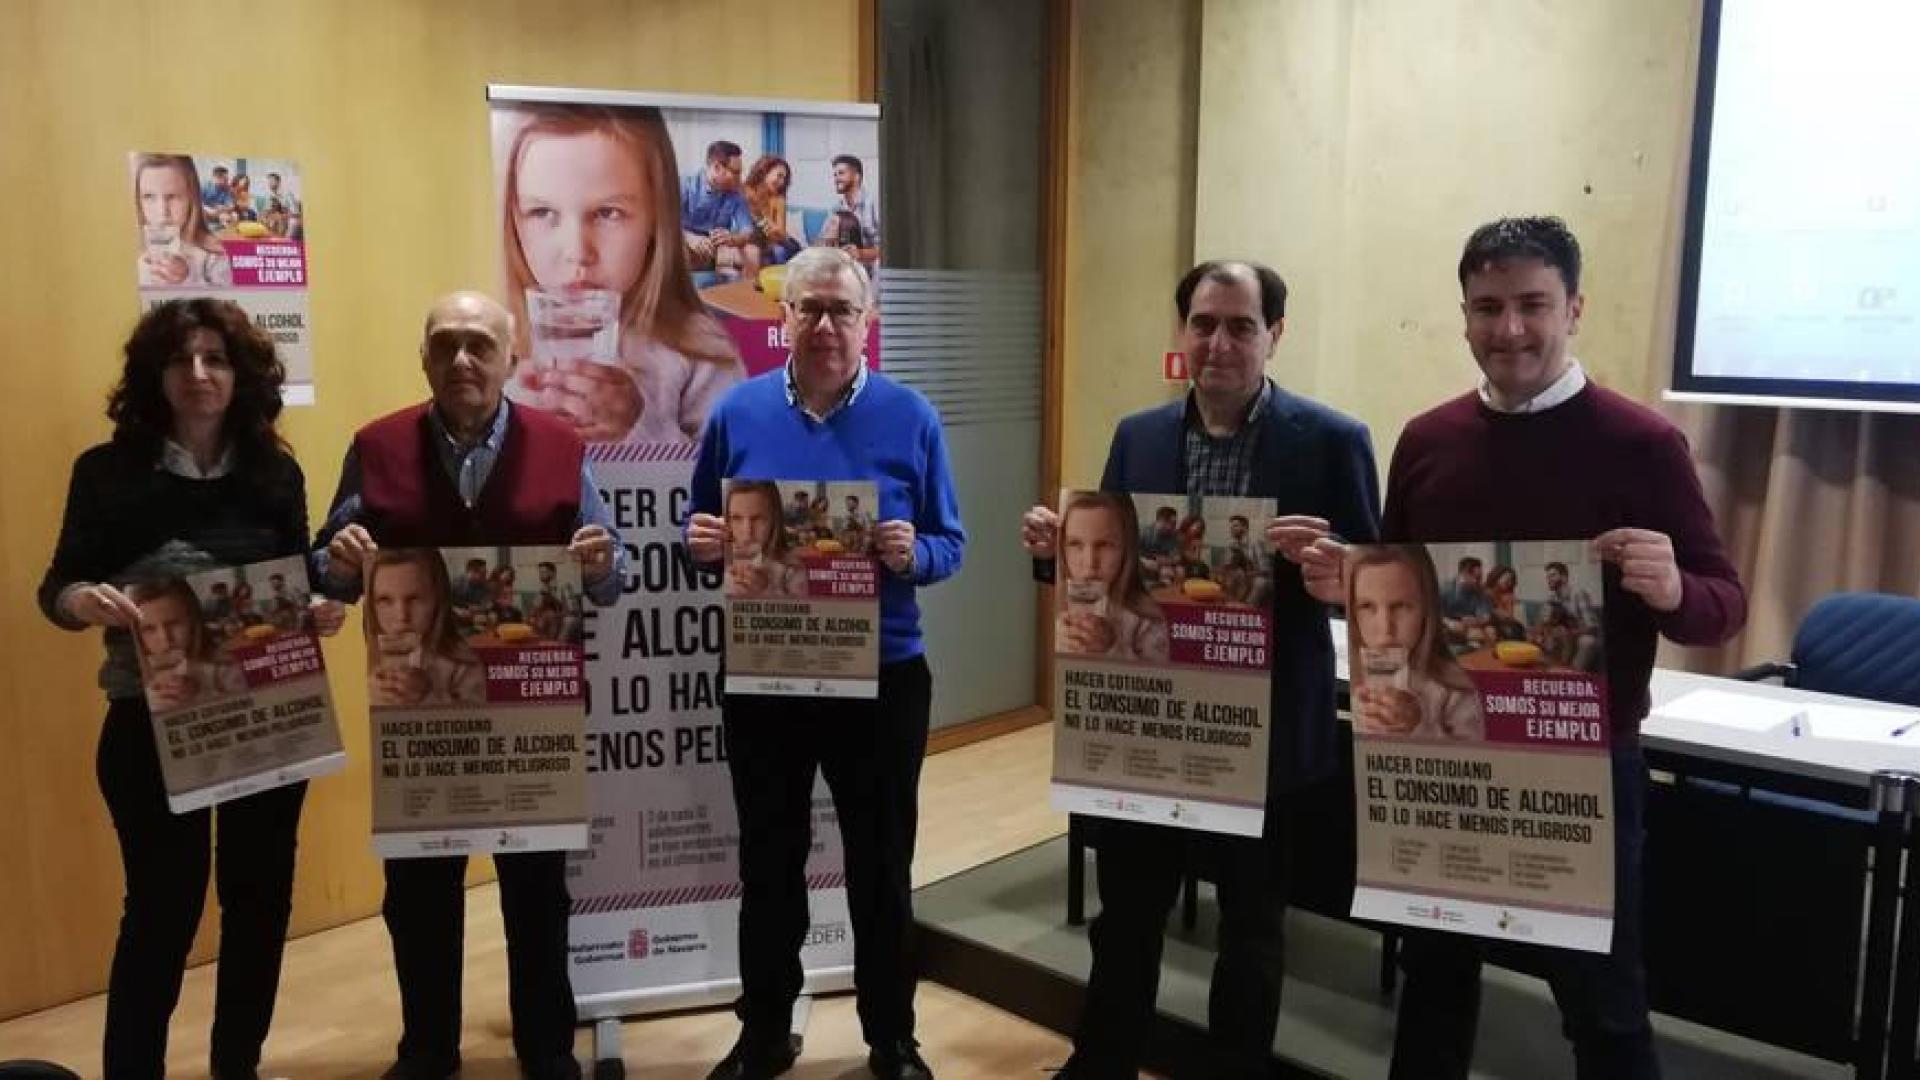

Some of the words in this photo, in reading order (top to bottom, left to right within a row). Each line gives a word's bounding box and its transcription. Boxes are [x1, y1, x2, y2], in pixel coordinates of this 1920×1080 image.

[622, 605, 724, 658] ALCO
[825, 618, 875, 632] ALCOHOL
[1173, 624, 1214, 640] SOMOS
[1231, 630, 1265, 646] MEJOR
[1204, 645, 1265, 664] EJEMPLO
[521, 681, 579, 697] EJEMPLO
[1065, 670, 1104, 688] HACER
[1108, 674, 1172, 694] COTIDIANO
[1523, 679, 1598, 697] RECUERDA:
[612, 676, 649, 715] LO
[1486, 695, 1535, 714] SOMOS
[1539, 700, 1555, 716] SU
[1559, 700, 1599, 717] MEJOR
[1065, 690, 1081, 709] EL
[1089, 691, 1159, 717] CONSUMO
[1166, 699, 1185, 720] DE
[1194, 703, 1262, 728] ALCOHOL
[381, 722, 422, 736] HACER
[426, 720, 492, 734] COTIDIANO
[1065, 714, 1081, 730] NO
[1085, 715, 1100, 731] LO
[1105, 719, 1137, 736] HACE
[1141, 721, 1183, 741] MENOS
[1186, 725, 1252, 748] PELIGROSO
[1526, 718, 1600, 741] EJEMPLO
[382, 740, 400, 759] EL
[408, 738, 480, 758] CONSUMO
[488, 736, 506, 755] DE
[514, 734, 580, 754] ALCOHOL
[382, 763, 399, 778] NO
[405, 763, 422, 777] LO
[426, 760, 456, 776] HACE
[464, 760, 504, 775] MENOS
[507, 758, 571, 773] PELIGROSO
[1366, 753, 1412, 774] HACER
[1415, 757, 1492, 780] COTIDIANO
[1367, 777, 1387, 799] EL
[1395, 779, 1478, 809] CONSUMO
[1487, 787, 1510, 812] DE
[1520, 789, 1604, 820] ALCOHOL
[1369, 804, 1386, 823] NO
[1394, 806, 1410, 825] LO
[1415, 809, 1451, 830] HACE
[1459, 812, 1509, 838] MENOS
[1513, 819, 1592, 844] PELIGROSO
